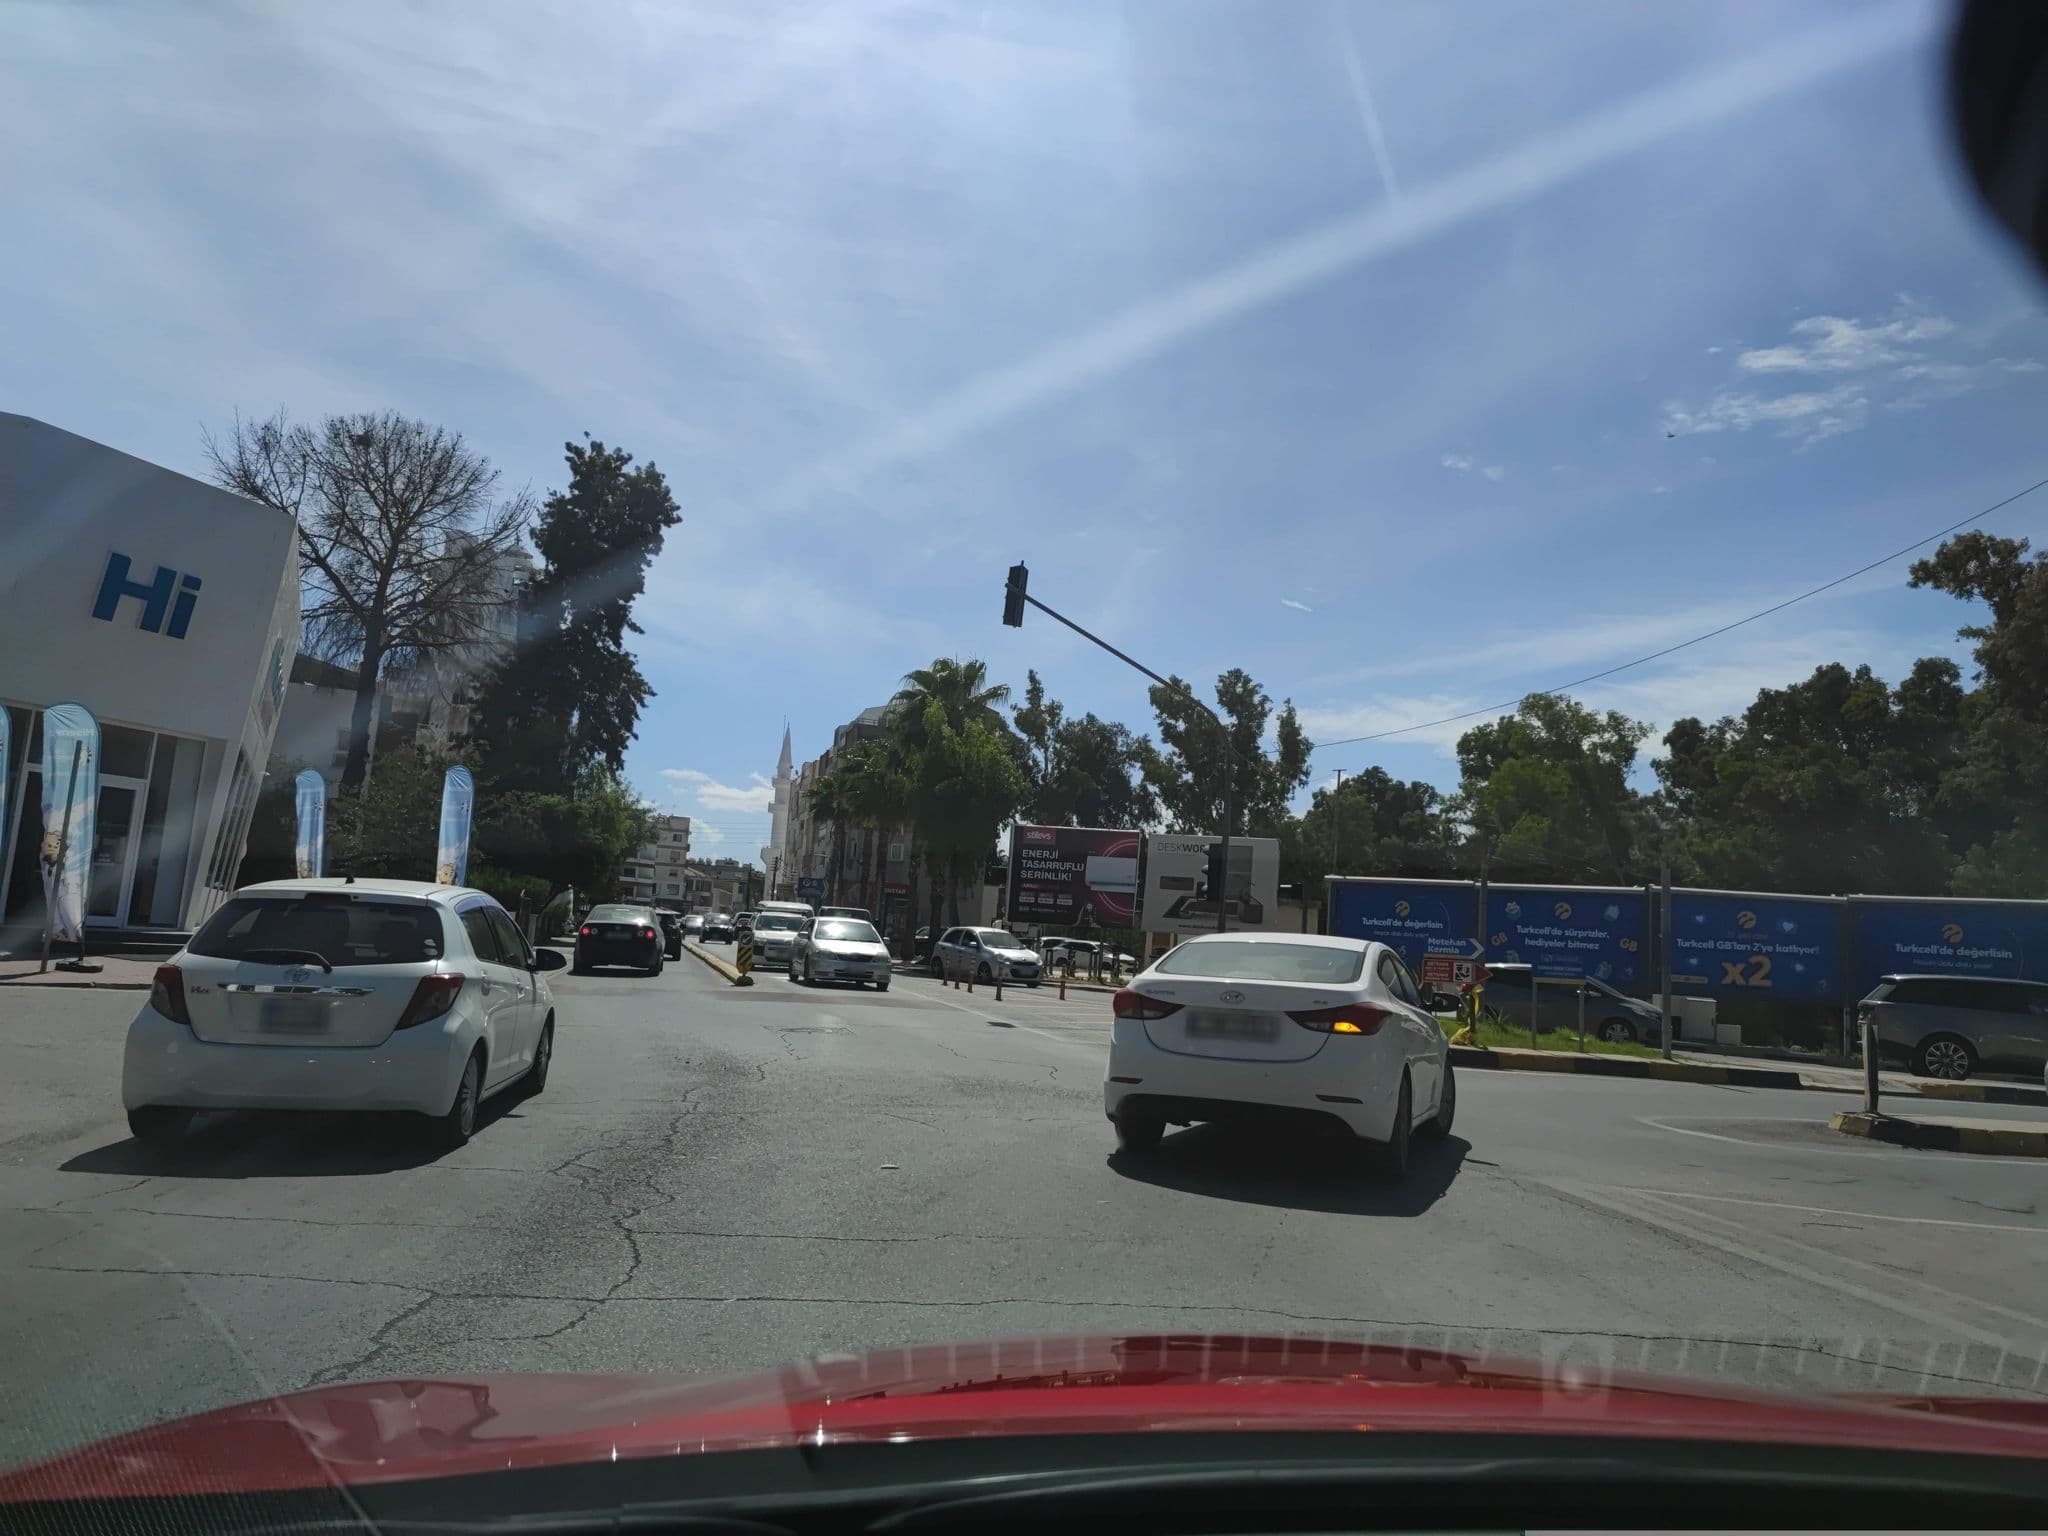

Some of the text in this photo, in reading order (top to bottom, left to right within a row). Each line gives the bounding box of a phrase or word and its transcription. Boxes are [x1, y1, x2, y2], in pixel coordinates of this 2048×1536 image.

[92, 552, 202, 640] Hi
[1022, 849, 1059, 859] ENERJİ
[1021, 860, 1085, 872] TASARRUFLU
[1020, 870, 1072, 881] SERİNLİK!
[1427, 937, 1466, 946] Metehan
[1524, 937, 1600, 950] hediyeler bitmez
[1676, 938, 1714, 949] Turkcell
[1895, 943, 2013, 959] Turkcell'de değerlisin
[1720, 954, 1774, 987] x2
